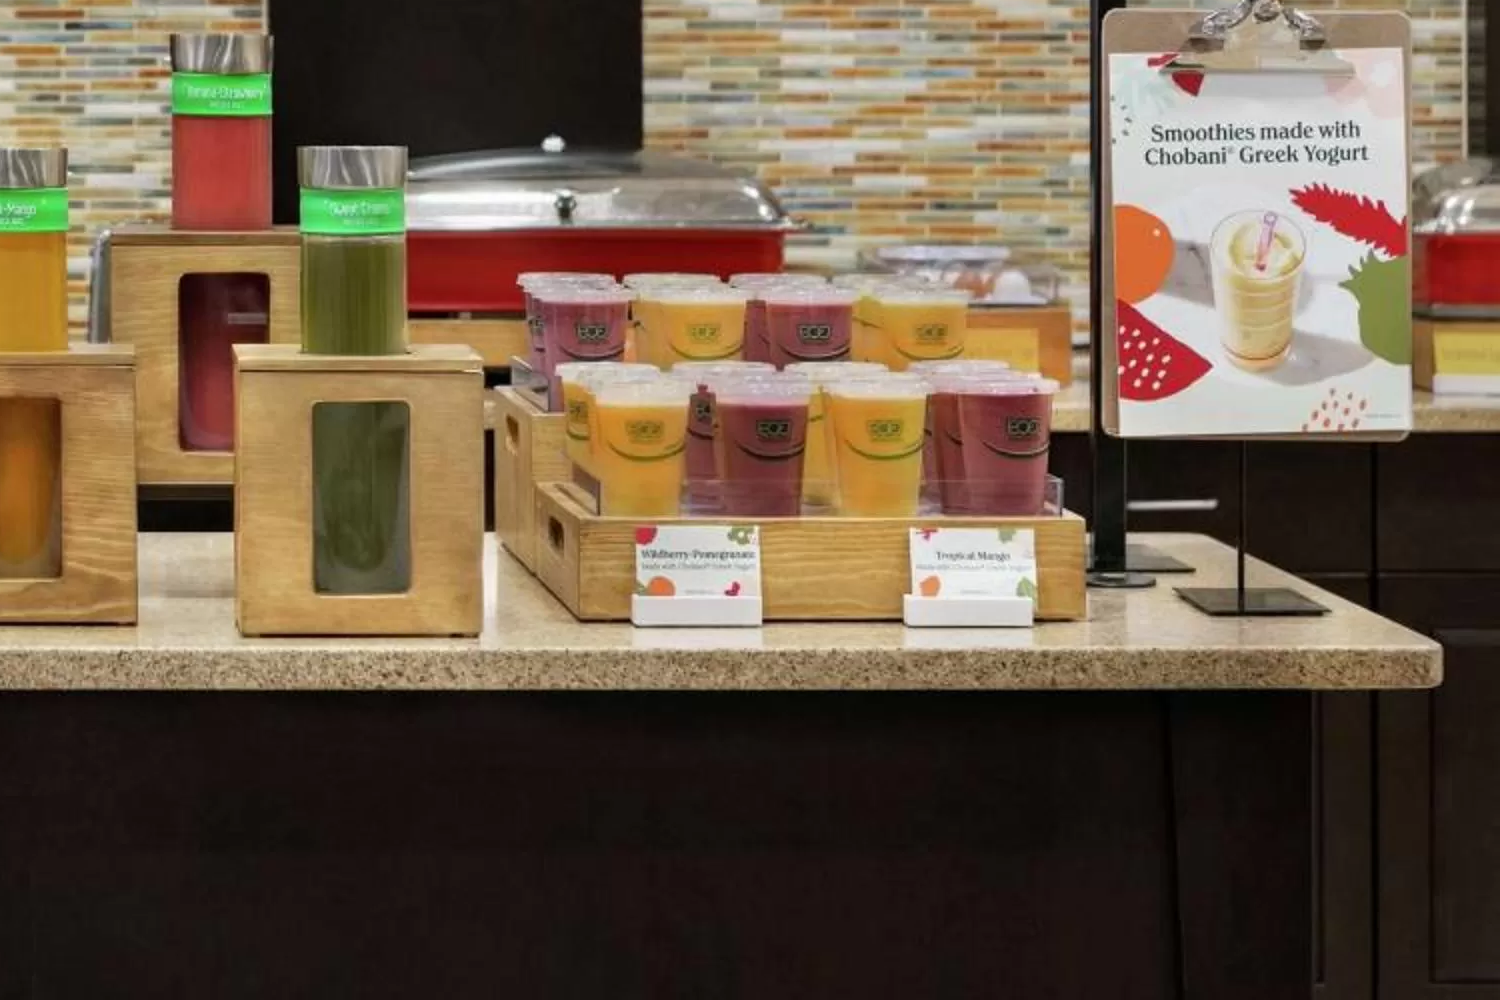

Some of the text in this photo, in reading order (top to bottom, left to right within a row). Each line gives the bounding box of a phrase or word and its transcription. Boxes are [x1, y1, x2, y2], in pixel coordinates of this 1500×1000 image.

[1151, 119, 1362, 143] Smoothies made with
[1239, 144, 1300, 164] Greek
[1303, 144, 1370, 167] Yogurt
[936, 550, 1011, 562] Tropical Mango
